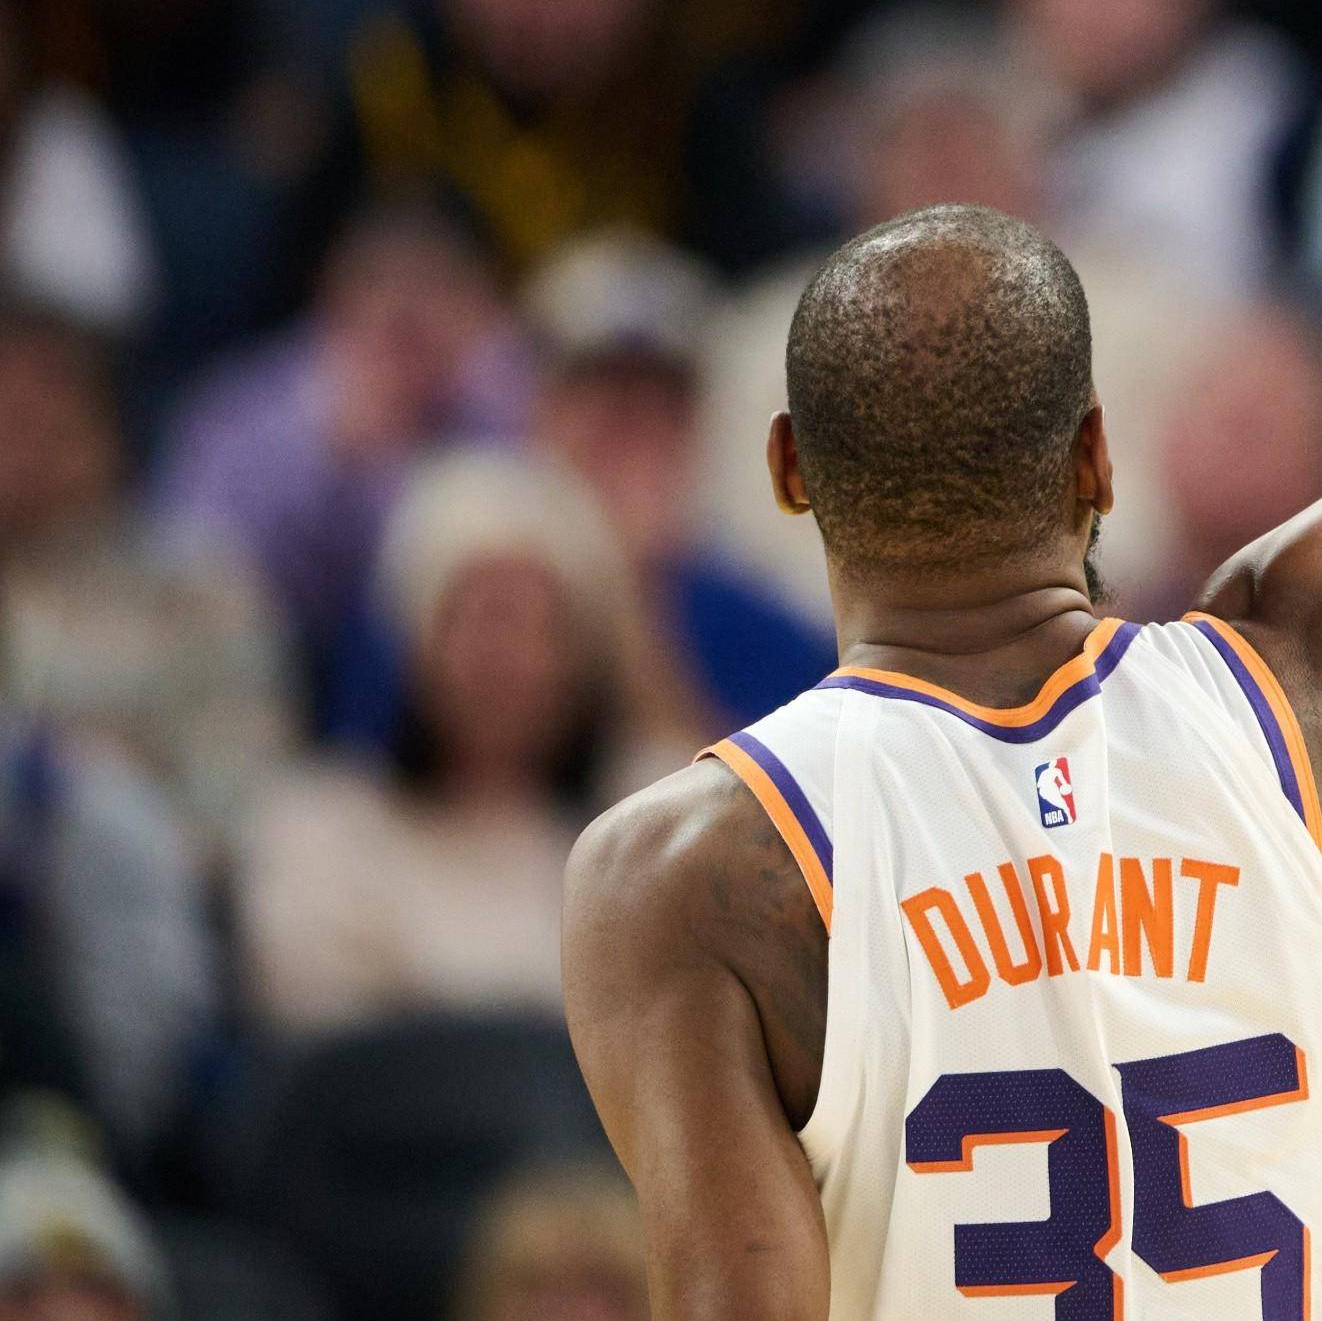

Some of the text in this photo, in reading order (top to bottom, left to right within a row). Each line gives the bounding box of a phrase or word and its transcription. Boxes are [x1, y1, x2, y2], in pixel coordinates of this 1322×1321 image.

[1044, 809, 1065, 826] NBA
[901, 852, 1240, 1010] DURANT
[906, 1032, 1311, 1321] 35
